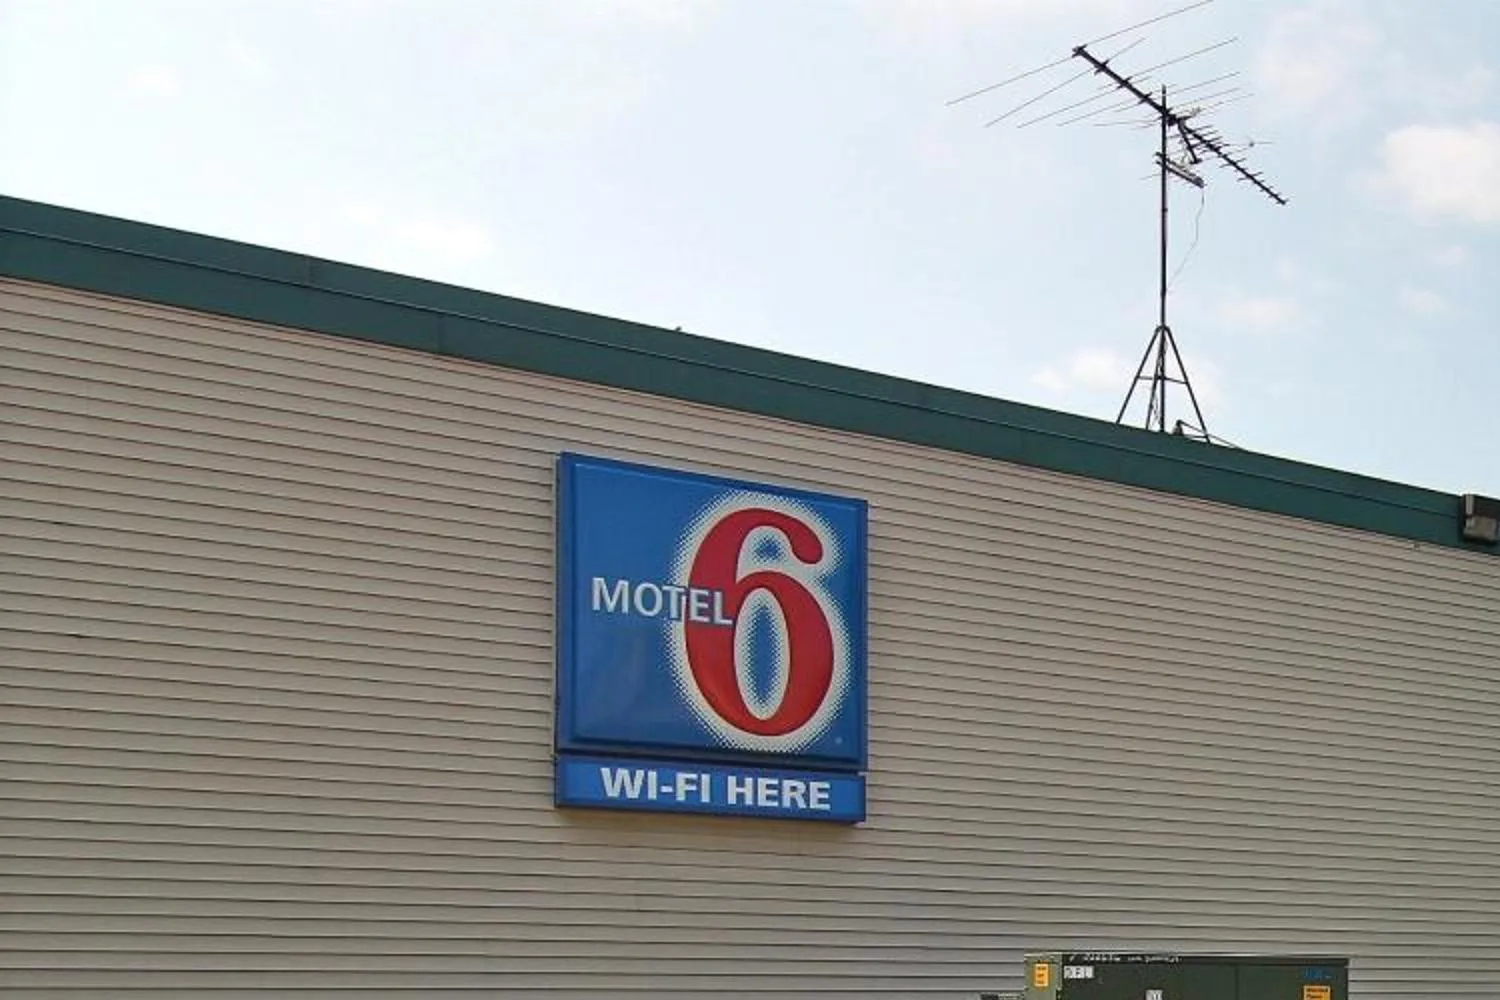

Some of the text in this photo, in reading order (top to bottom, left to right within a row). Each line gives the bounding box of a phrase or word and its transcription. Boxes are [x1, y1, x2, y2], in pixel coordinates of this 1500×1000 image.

[591, 506, 835, 738] MOTEL 6
[600, 767, 832, 811] WI-FI HERE
